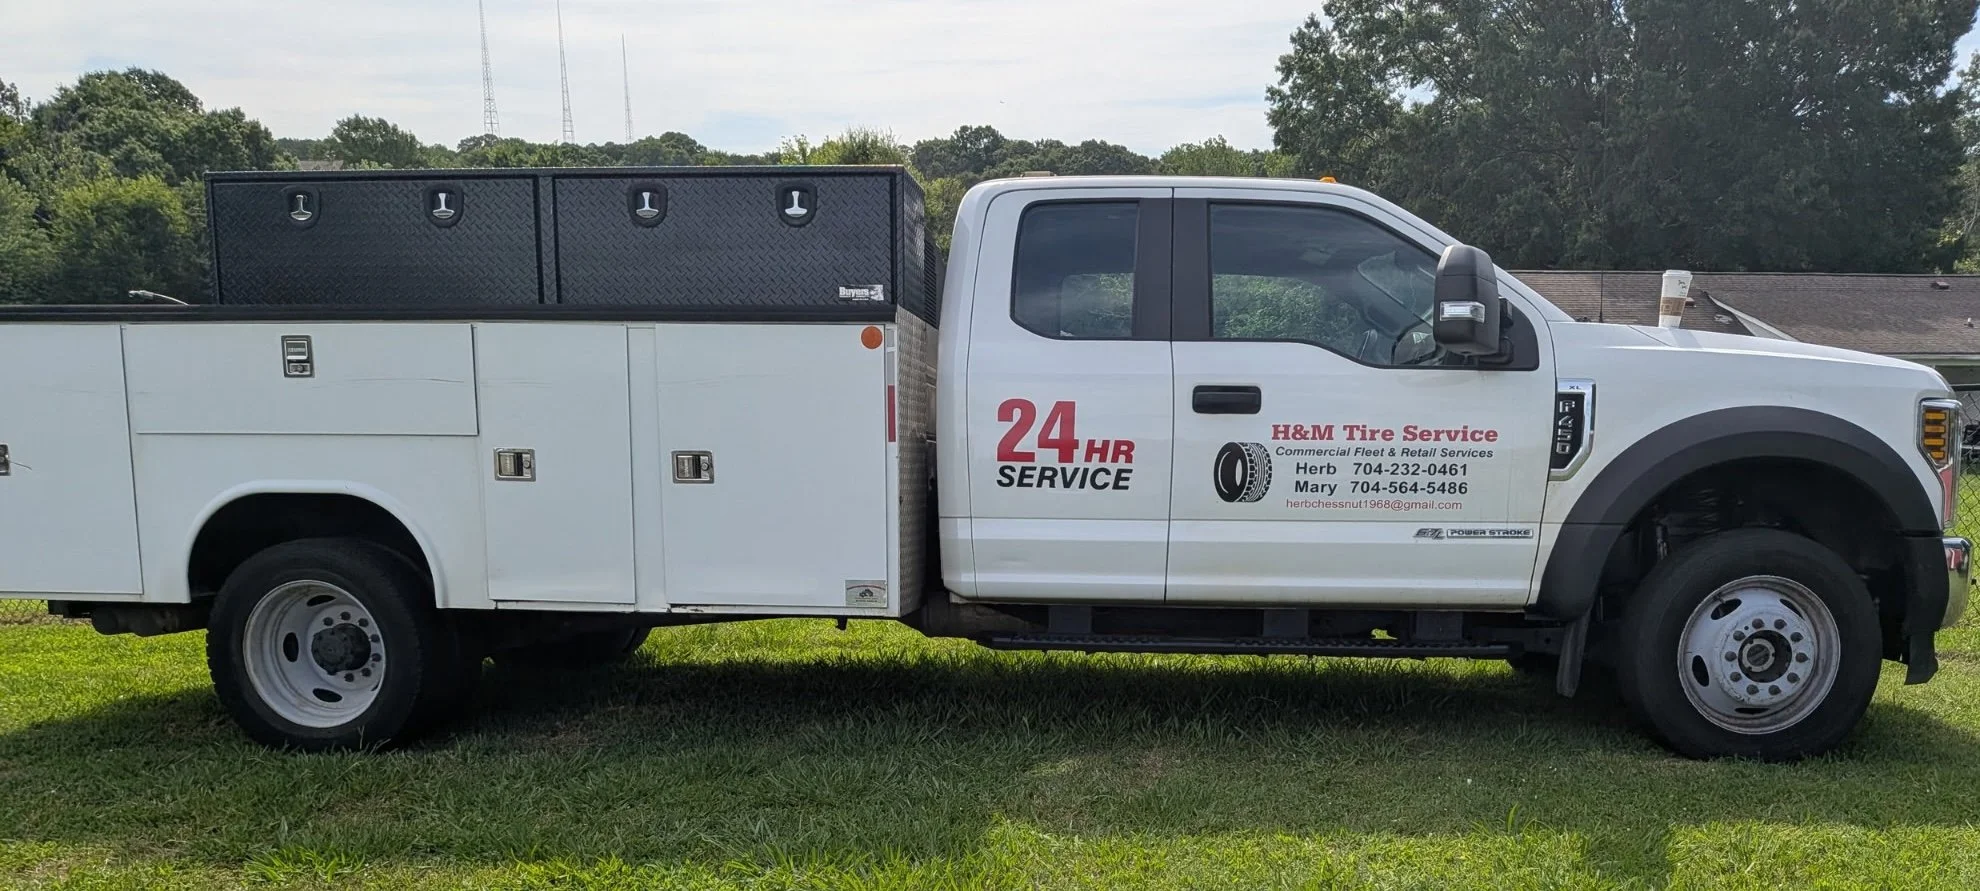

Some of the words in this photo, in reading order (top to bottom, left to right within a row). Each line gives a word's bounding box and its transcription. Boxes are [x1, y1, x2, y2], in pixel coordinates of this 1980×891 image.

[839, 286, 870, 298] Buyers
[997, 398, 1079, 464] 24
[1084, 439, 1135, 464] HR
[1271, 424, 1334, 441] H&M
[1343, 424, 1395, 441] Tire
[1402, 425, 1498, 442] Service
[1275, 446, 1350, 457] Commercial
[1354, 447, 1385, 457] Fleet
[1388, 448, 1396, 457] &
[1400, 448, 1437, 458] Retail
[1440, 448, 1494, 459] Services
[1296, 462, 1337, 475] Herb
[1353, 462, 1468, 476] 704-232-0461
[996, 465, 1133, 491] SERVICE
[1294, 480, 1338, 496] Mary
[1350, 481, 1468, 494] 704-564-5486
[1286, 498, 1463, 511] herbchessnut1968@gmail.com
